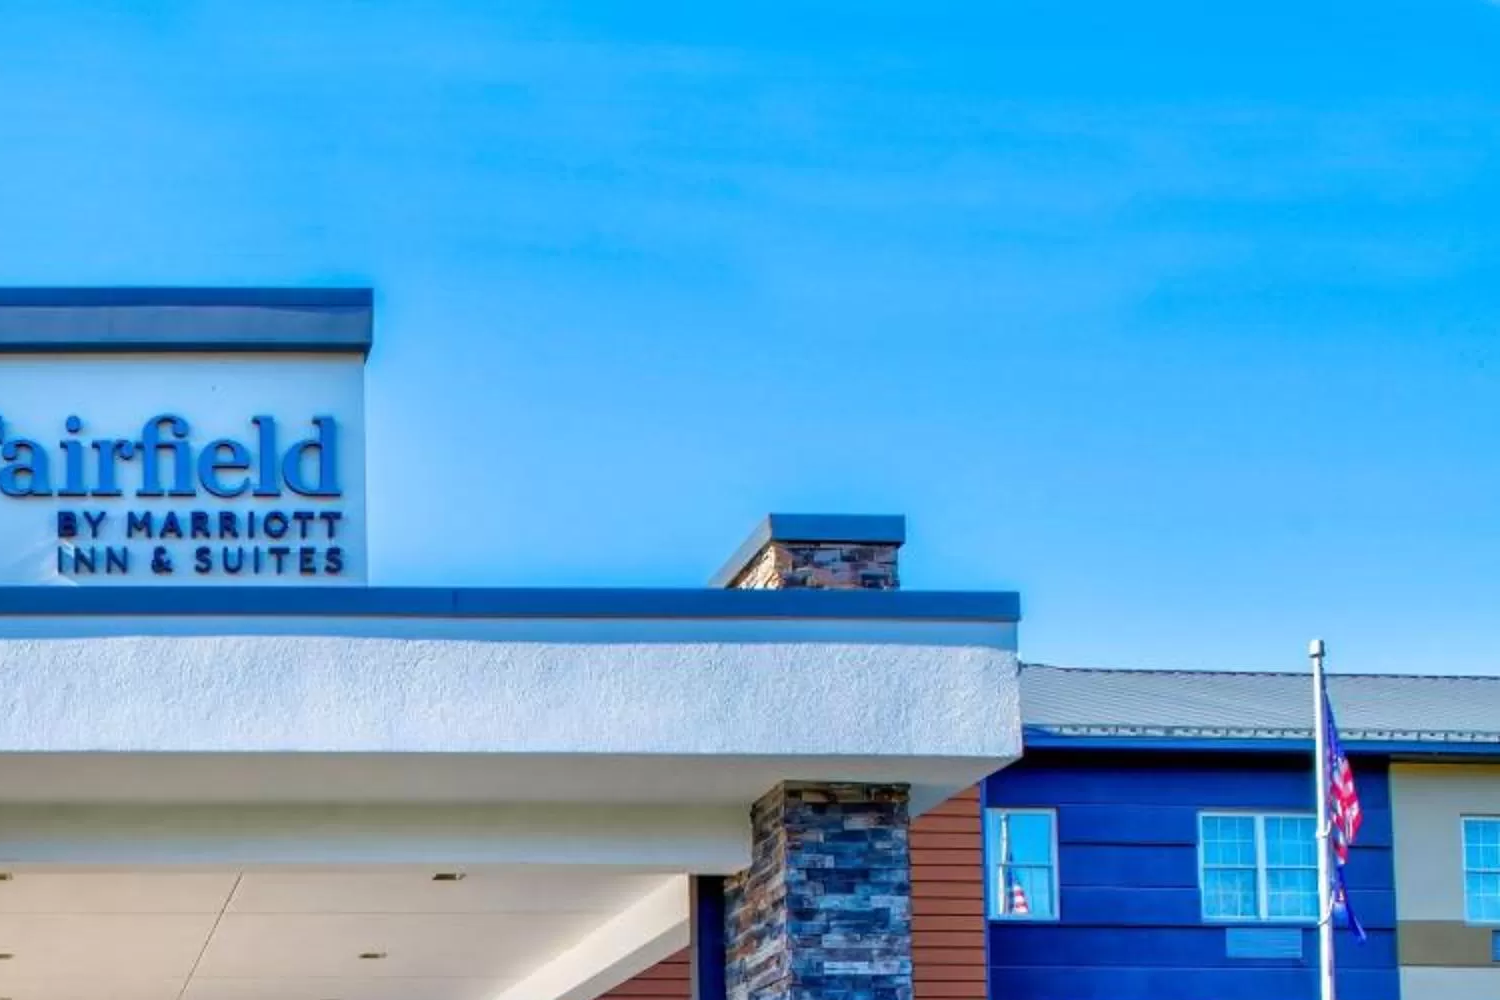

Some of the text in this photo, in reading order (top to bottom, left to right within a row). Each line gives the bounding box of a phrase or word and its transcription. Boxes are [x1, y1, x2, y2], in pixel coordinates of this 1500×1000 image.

[57, 511, 343, 538] BY MARRIOTT
[57, 546, 344, 574] INN & SUITES
